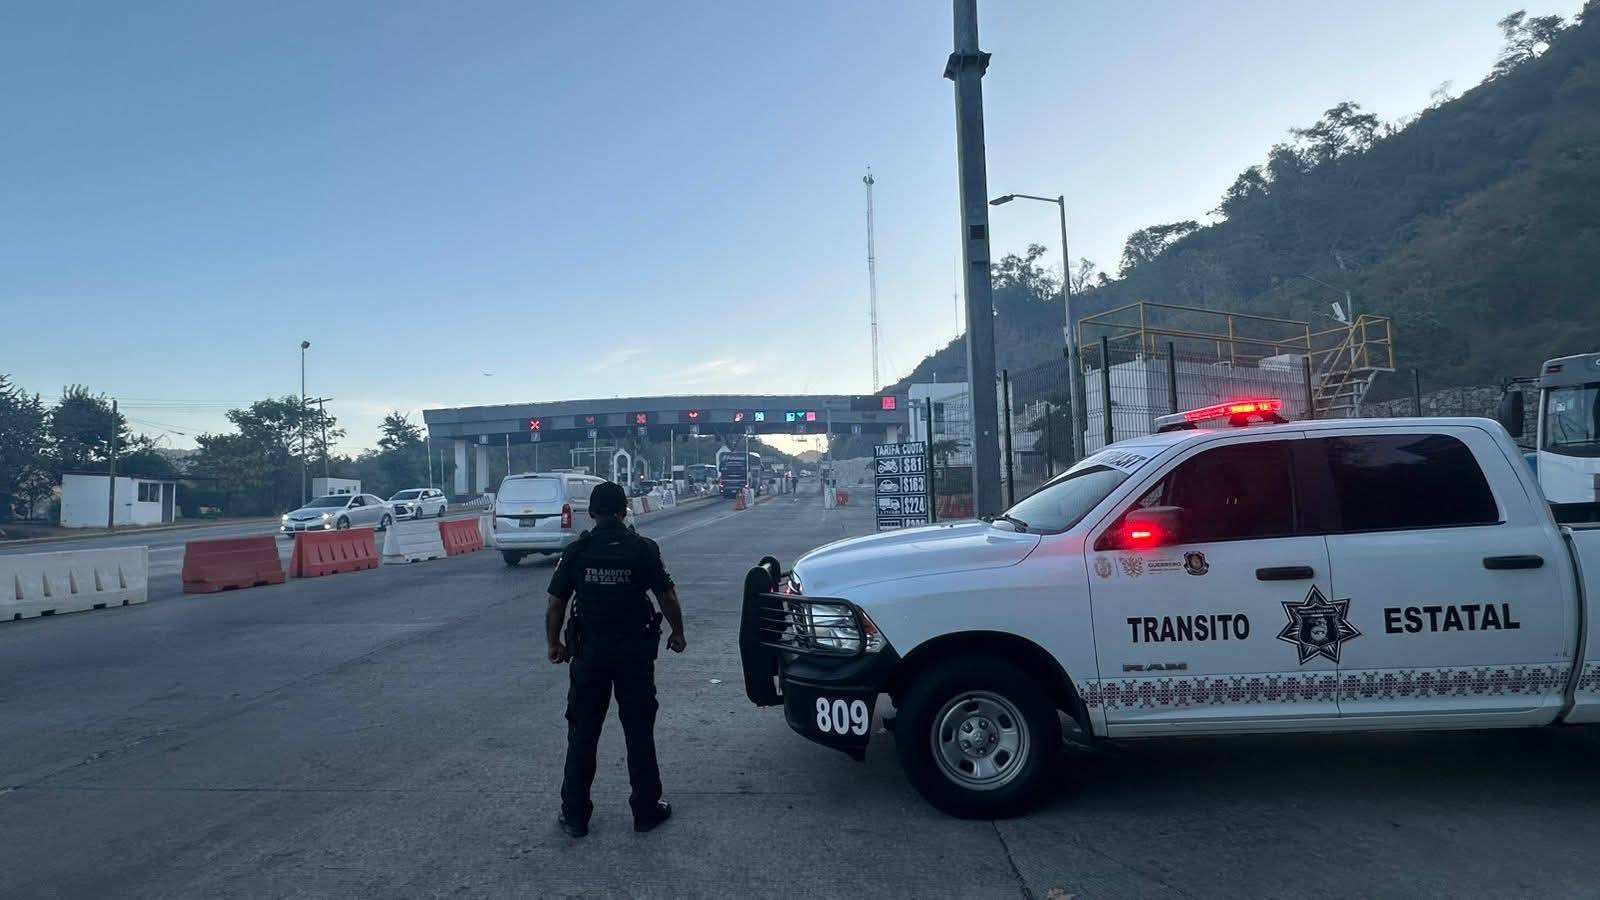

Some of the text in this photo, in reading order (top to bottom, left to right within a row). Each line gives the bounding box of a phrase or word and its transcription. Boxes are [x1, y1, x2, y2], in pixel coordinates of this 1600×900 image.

[875, 443, 924, 456] TARIFA CUOTA
[903, 457, 922, 473] $81
[903, 477, 924, 493] $163
[904, 497, 925, 514] $224
[1126, 603, 1521, 643] TRANSITO ESTATAL
[815, 697, 869, 736] 809
